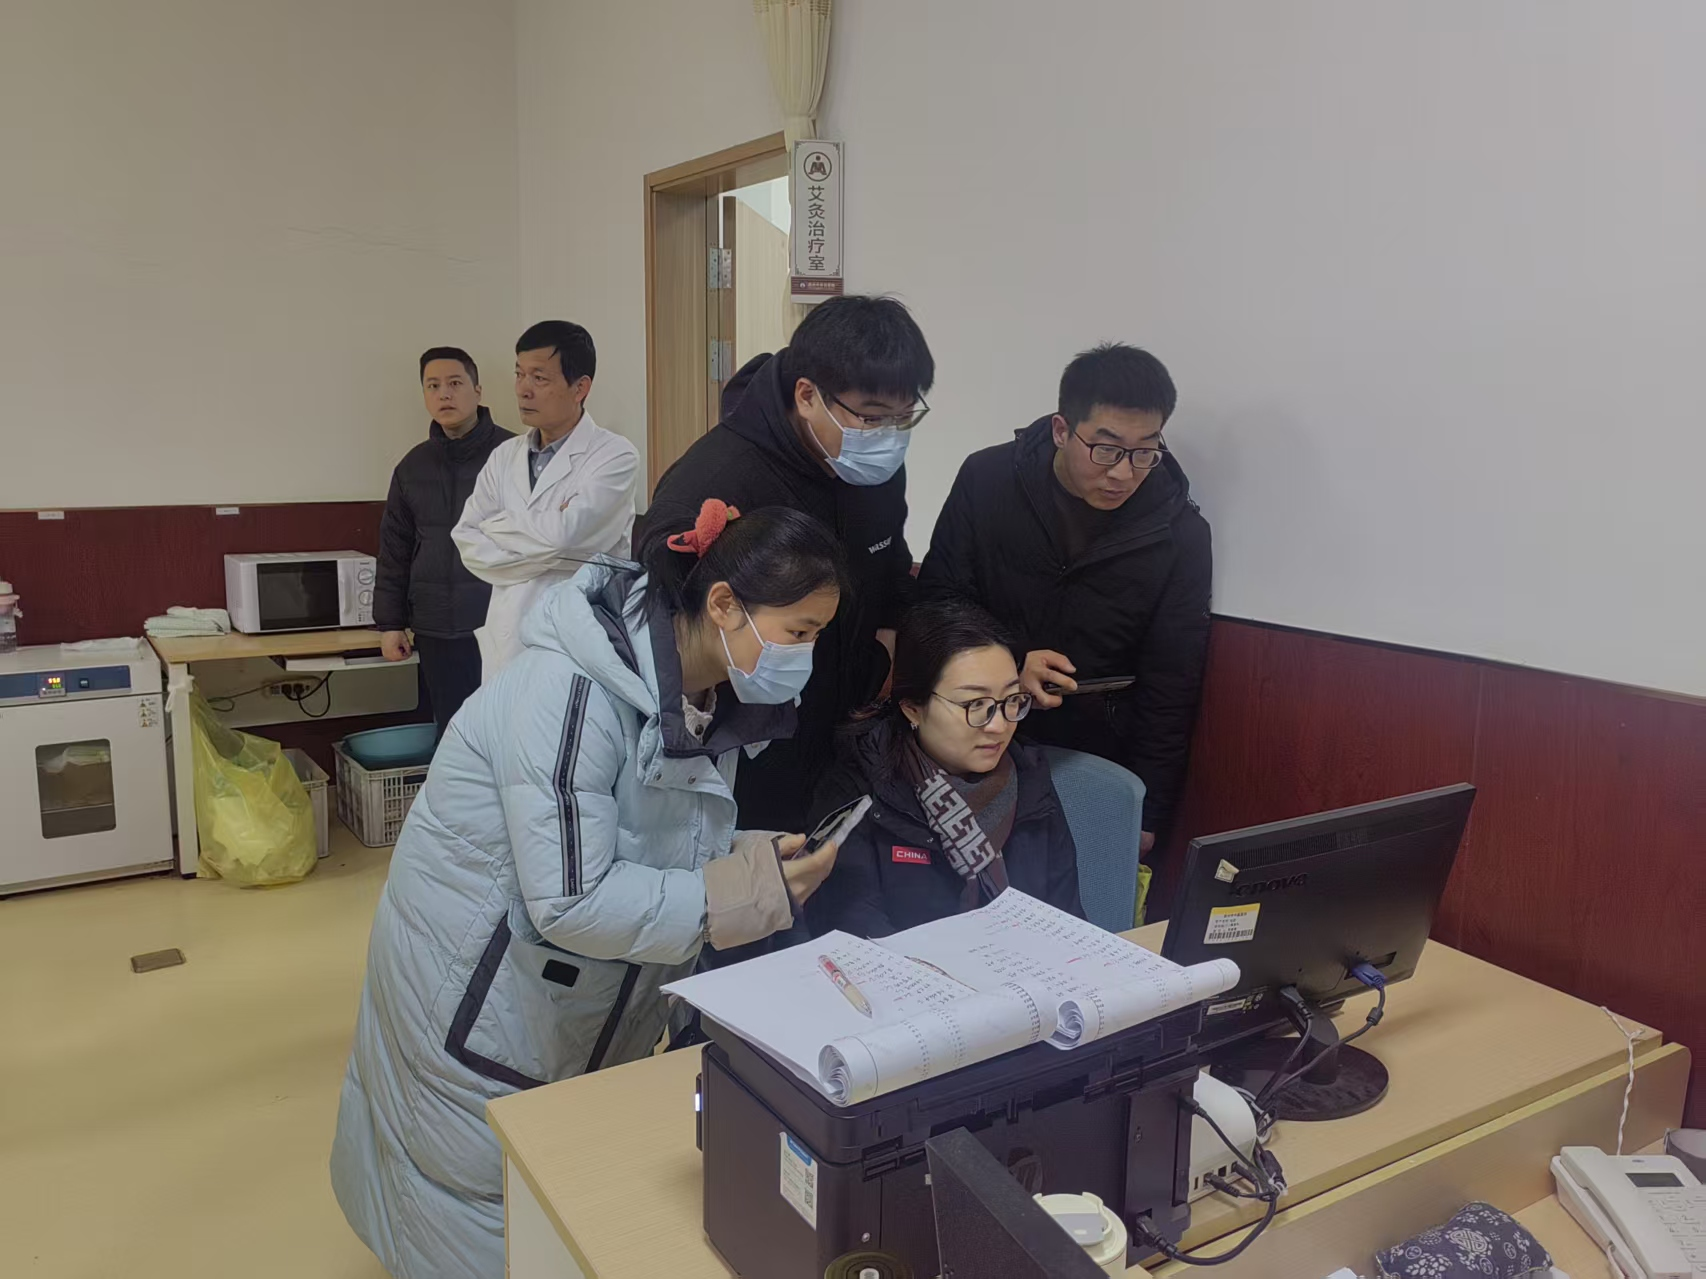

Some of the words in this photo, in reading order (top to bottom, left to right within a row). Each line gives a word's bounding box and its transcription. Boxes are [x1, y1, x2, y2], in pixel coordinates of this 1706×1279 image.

[808, 185, 825, 271] 艾灸治疗室
[896, 850, 928, 860] CHINA
